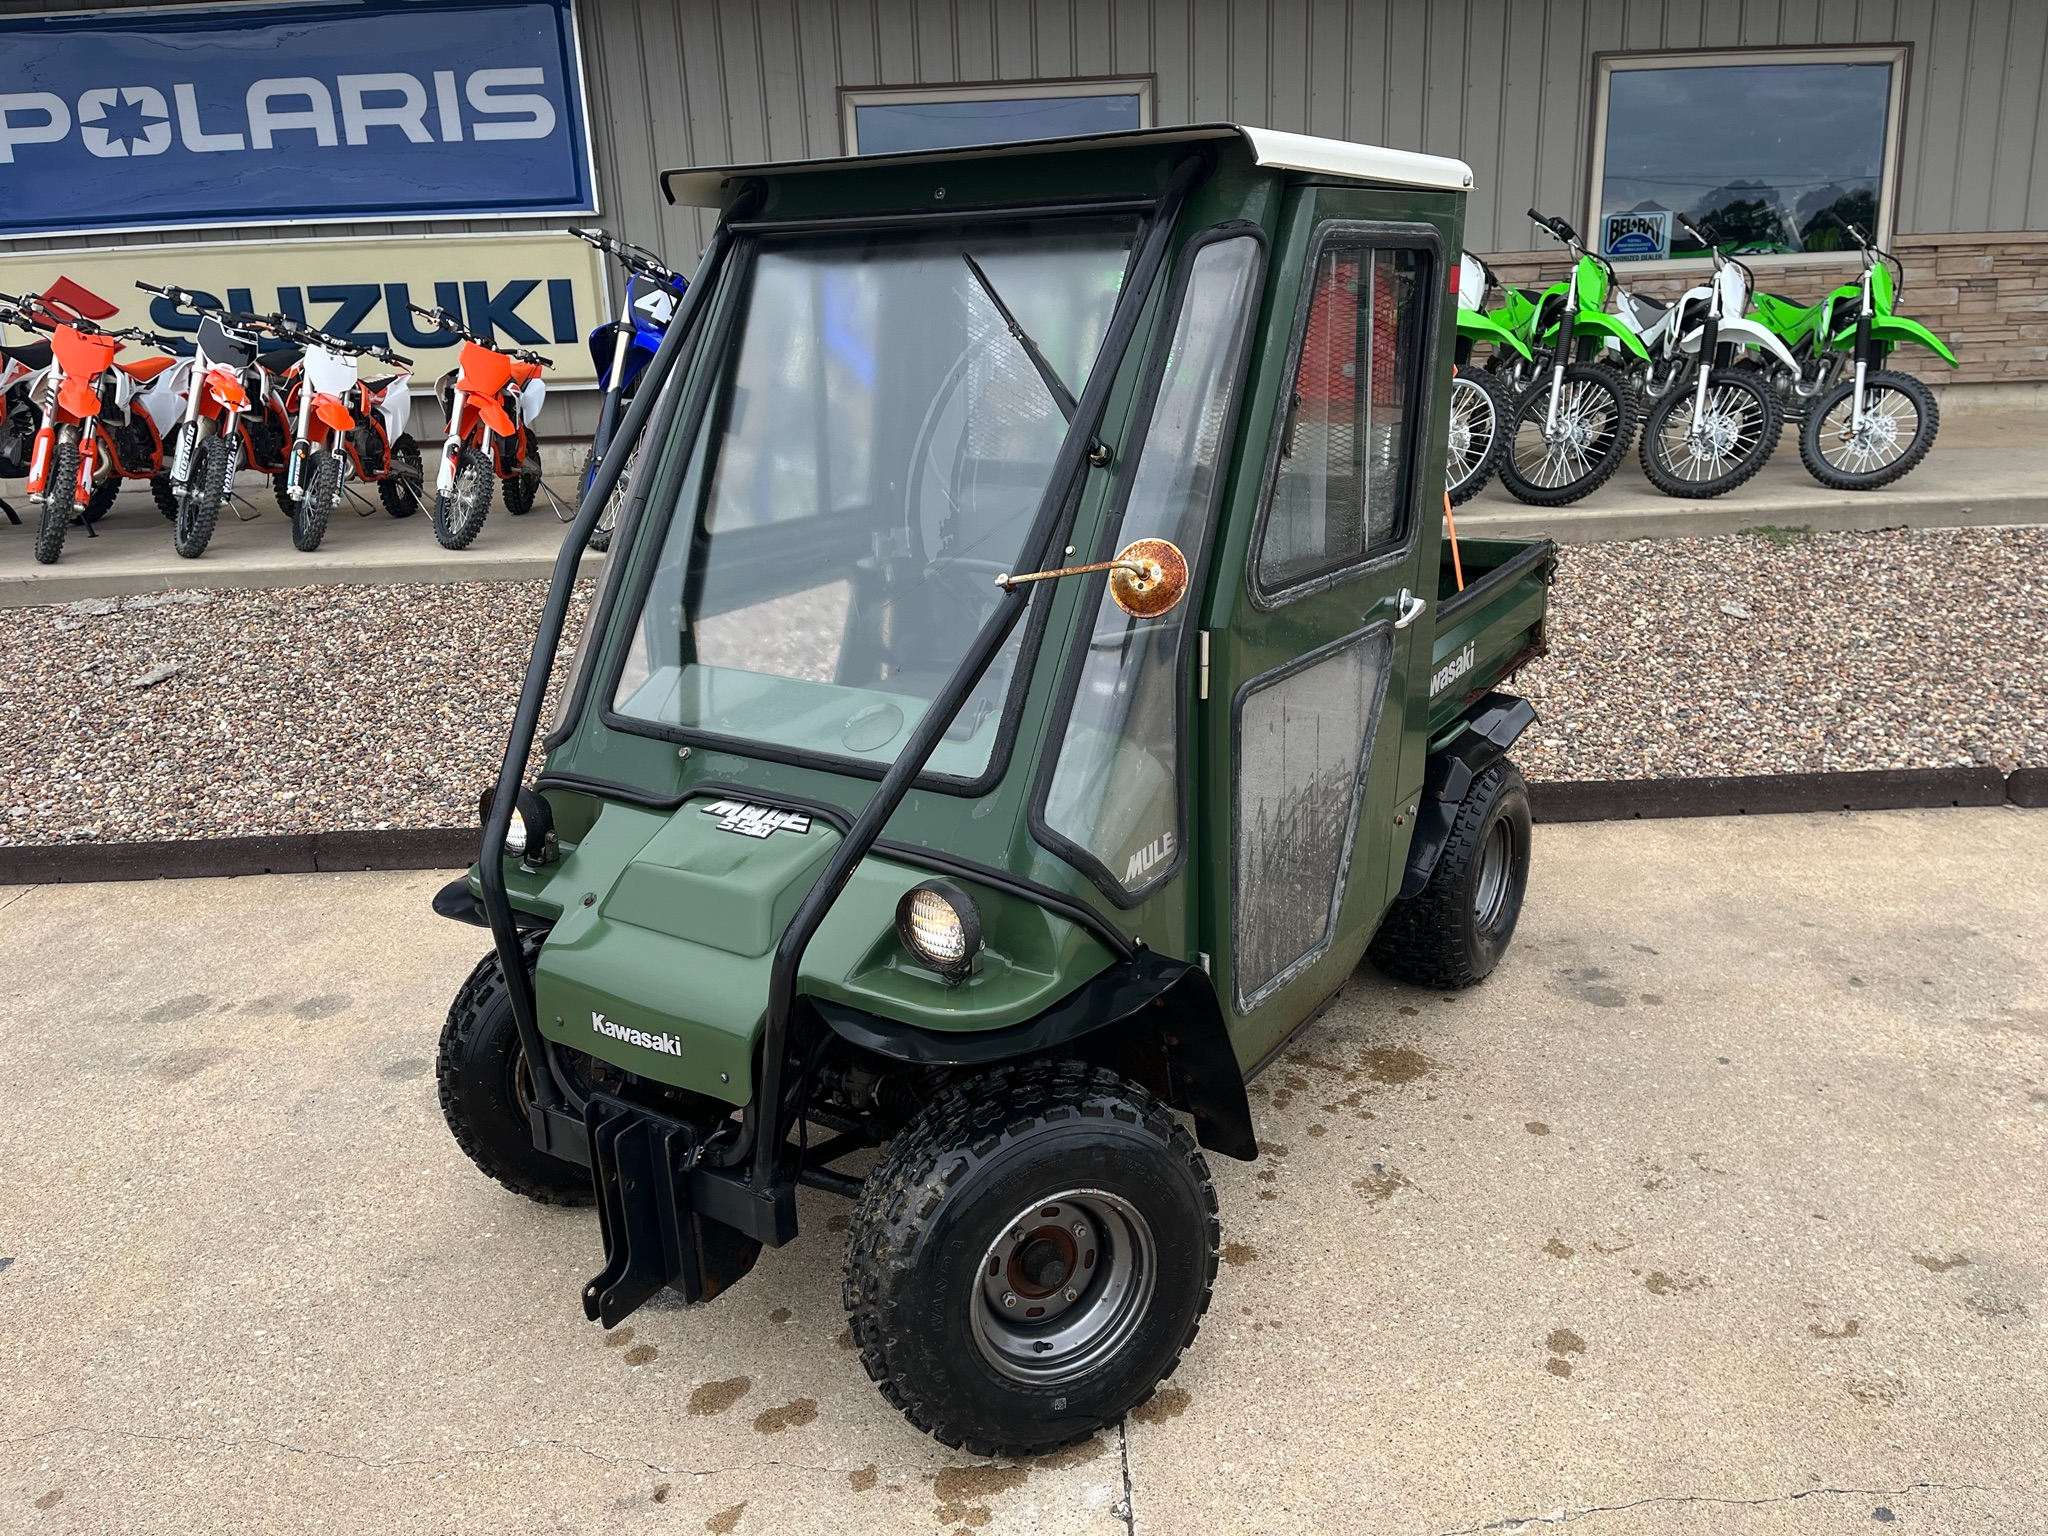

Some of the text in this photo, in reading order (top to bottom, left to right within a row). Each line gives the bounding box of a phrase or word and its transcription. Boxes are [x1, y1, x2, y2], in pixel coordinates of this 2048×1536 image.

[0, 66, 557, 164] POLARIS
[149, 278, 579, 358] SUZUKI
[633, 289, 678, 324] 4
[179, 423, 197, 480] DUNLOP
[1429, 639, 1475, 698] wasaki
[1123, 830, 1177, 885] MULE
[591, 1010, 683, 1058] Kawasaki
